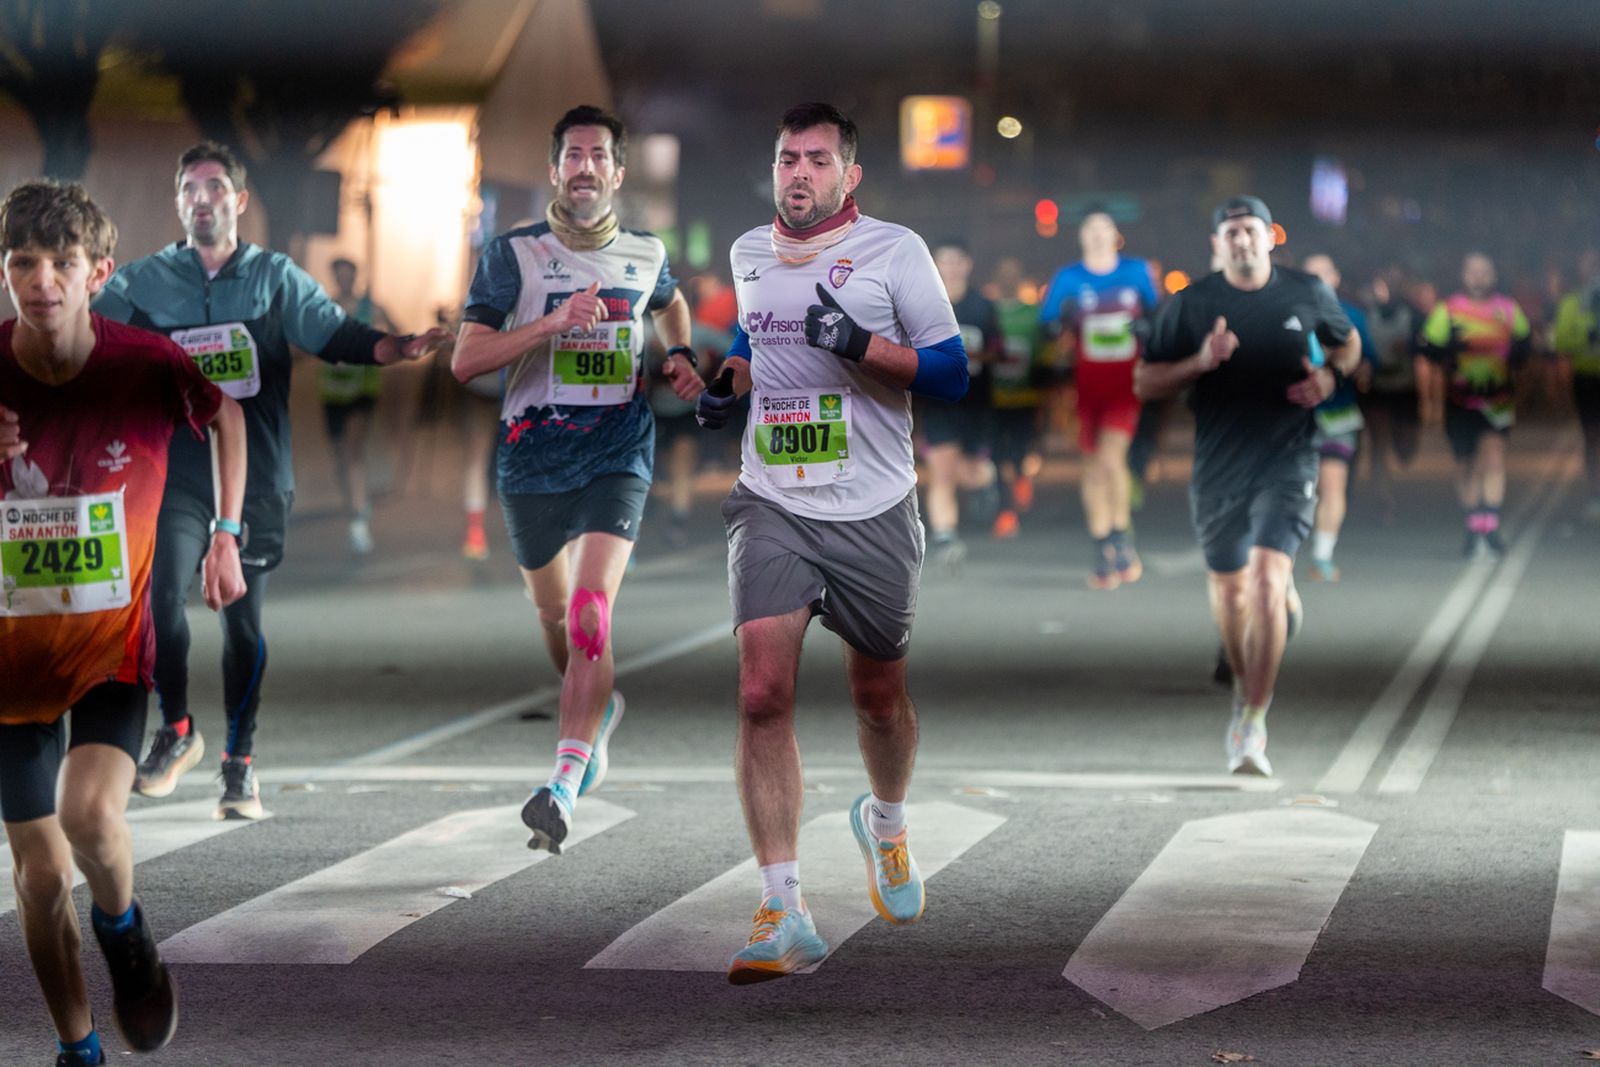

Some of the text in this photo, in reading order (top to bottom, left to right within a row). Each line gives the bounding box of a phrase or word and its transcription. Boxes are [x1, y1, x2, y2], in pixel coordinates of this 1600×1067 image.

[761, 335, 791, 346] castro
[192, 351, 243, 375] 835
[576, 352, 616, 376] 981
[771, 400, 796, 411] NOCHE
[798, 399, 810, 409] DE
[763, 413, 779, 424] SAN
[780, 410, 811, 423] ANTÓN
[769, 424, 830, 455] 8907
[22, 511, 77, 524] NOCHE DE
[9, 527, 34, 540] SAN
[37, 524, 78, 539] ANTÓN
[21, 537, 104, 575] 2429
